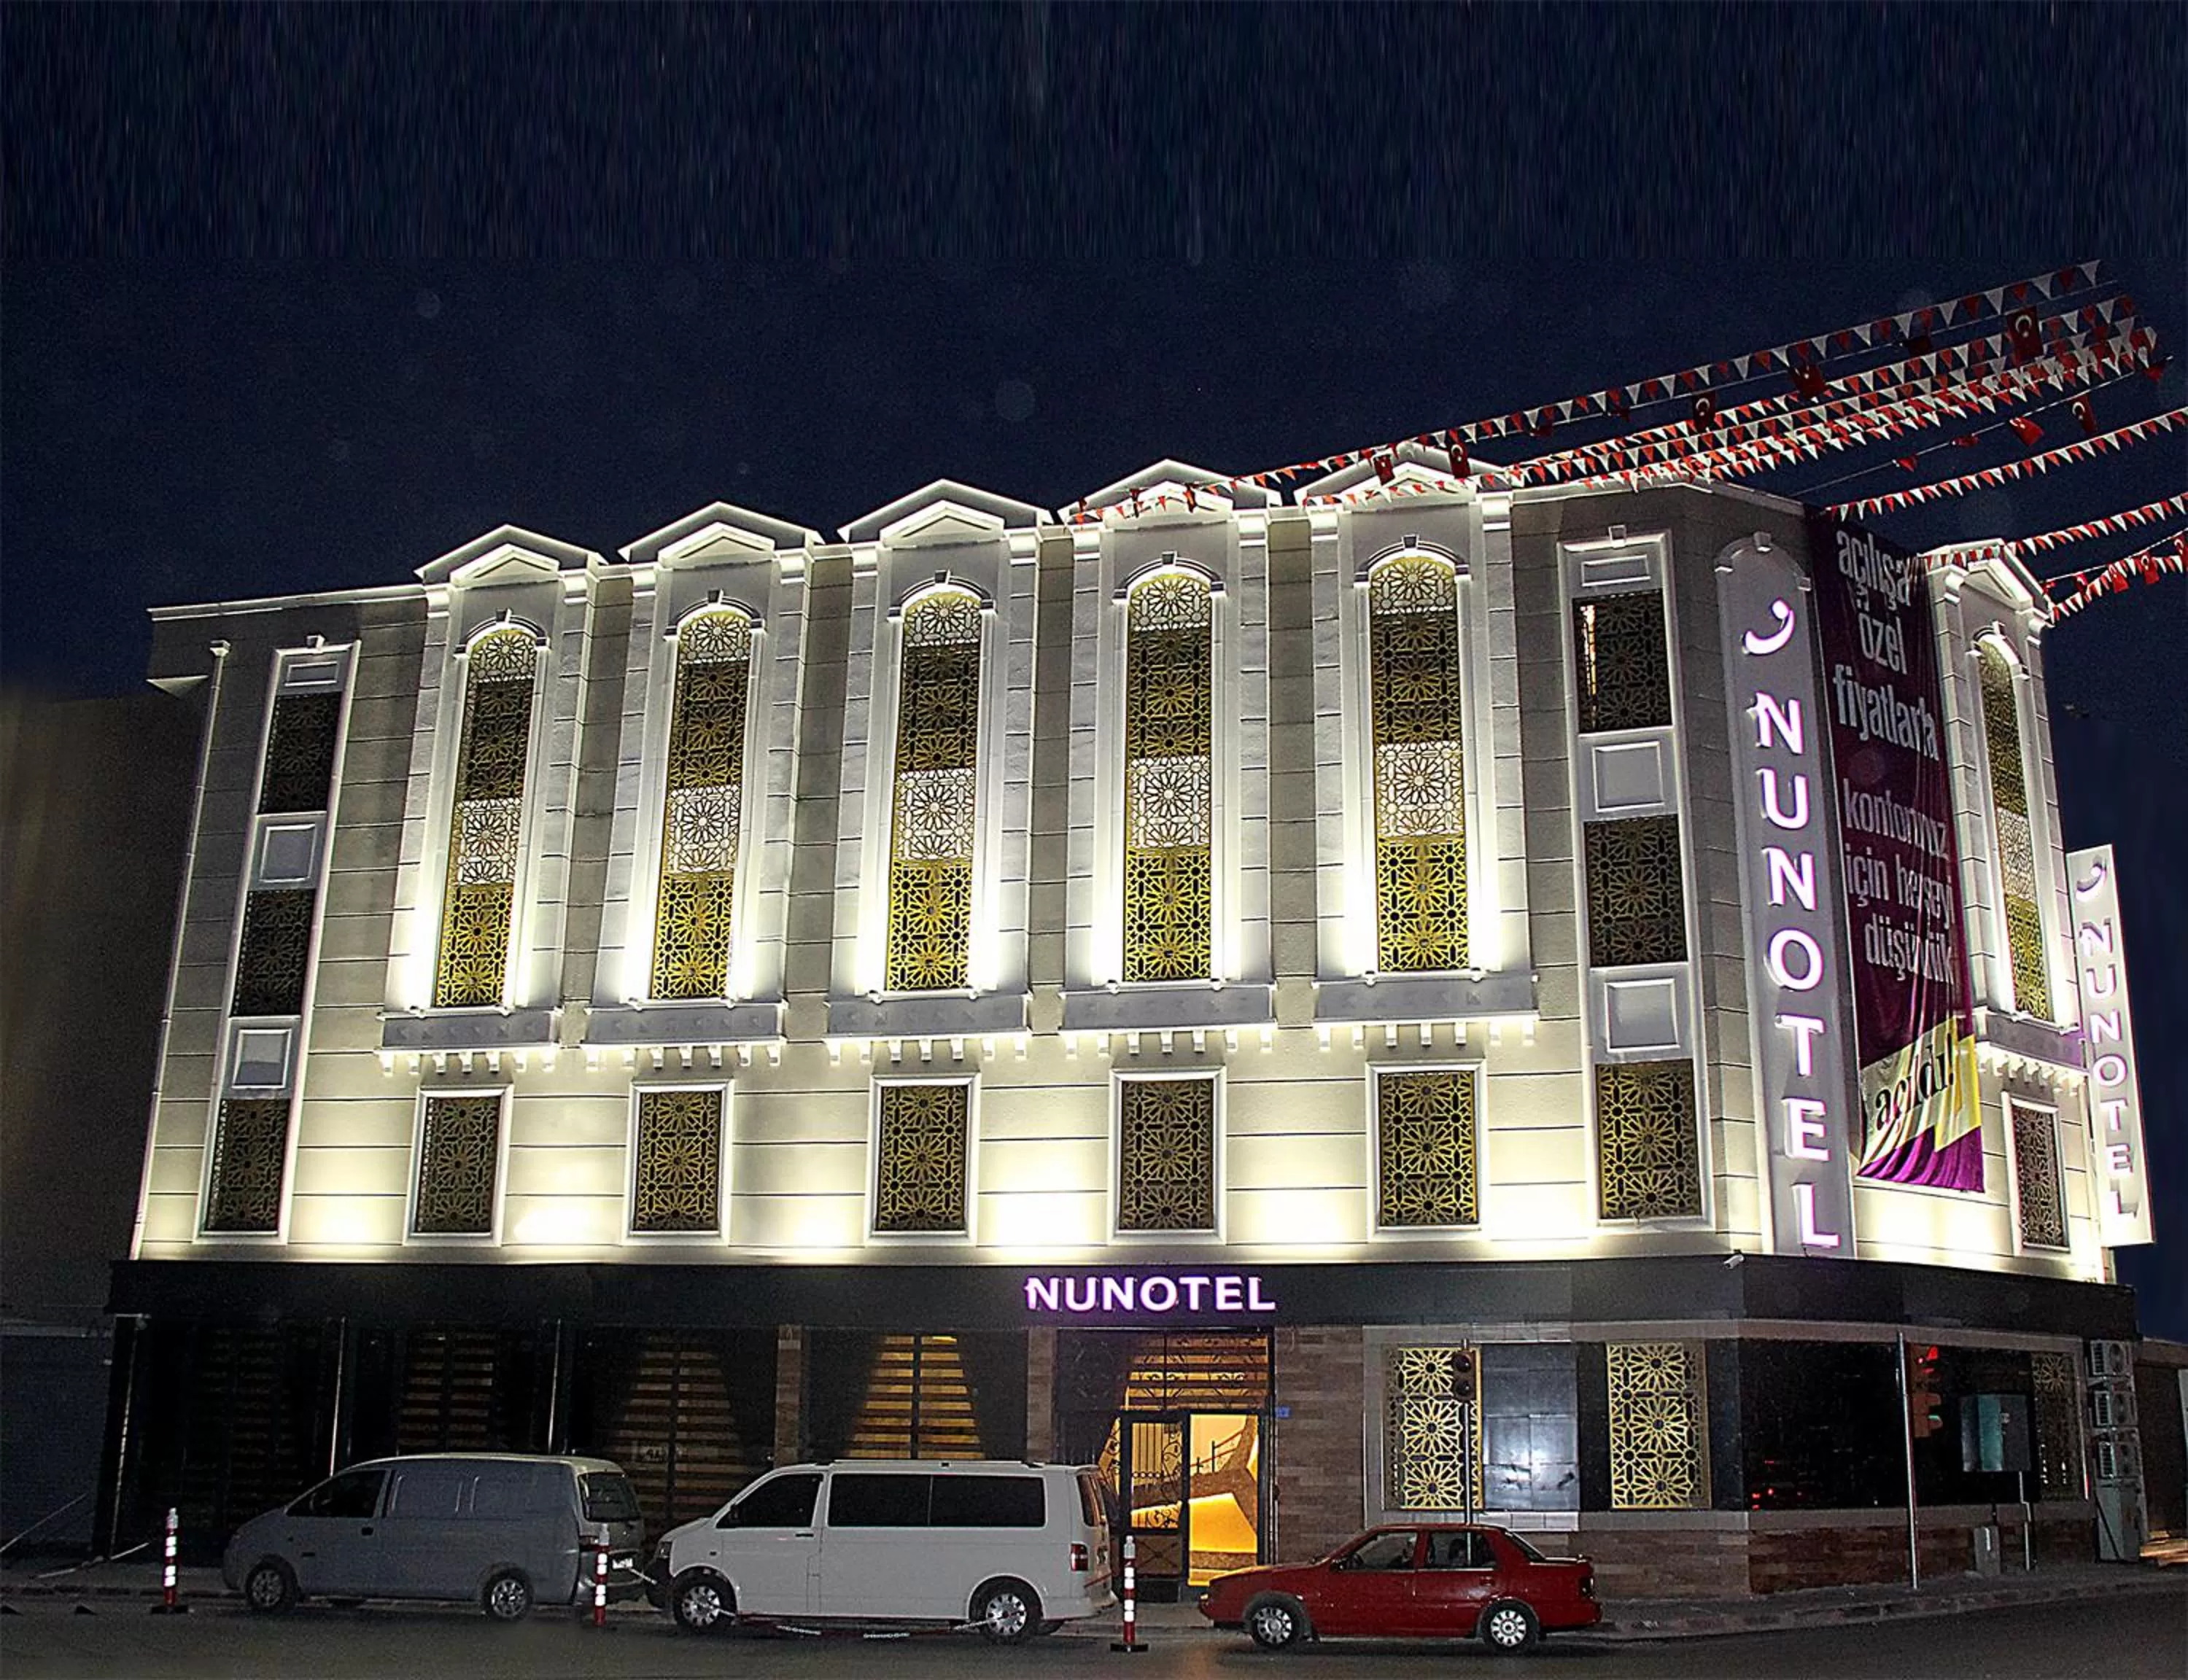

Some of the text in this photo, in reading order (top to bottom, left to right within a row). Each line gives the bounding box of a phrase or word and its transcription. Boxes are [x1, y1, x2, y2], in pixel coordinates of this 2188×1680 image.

[1856, 599, 1907, 674] özel
[1844, 843, 1889, 907] için
[1752, 692, 1840, 1248] NUNOTEL
[2081, 917, 2138, 1224] NUNOTEL
[1025, 1277, 1276, 1311] NUNOTEL
